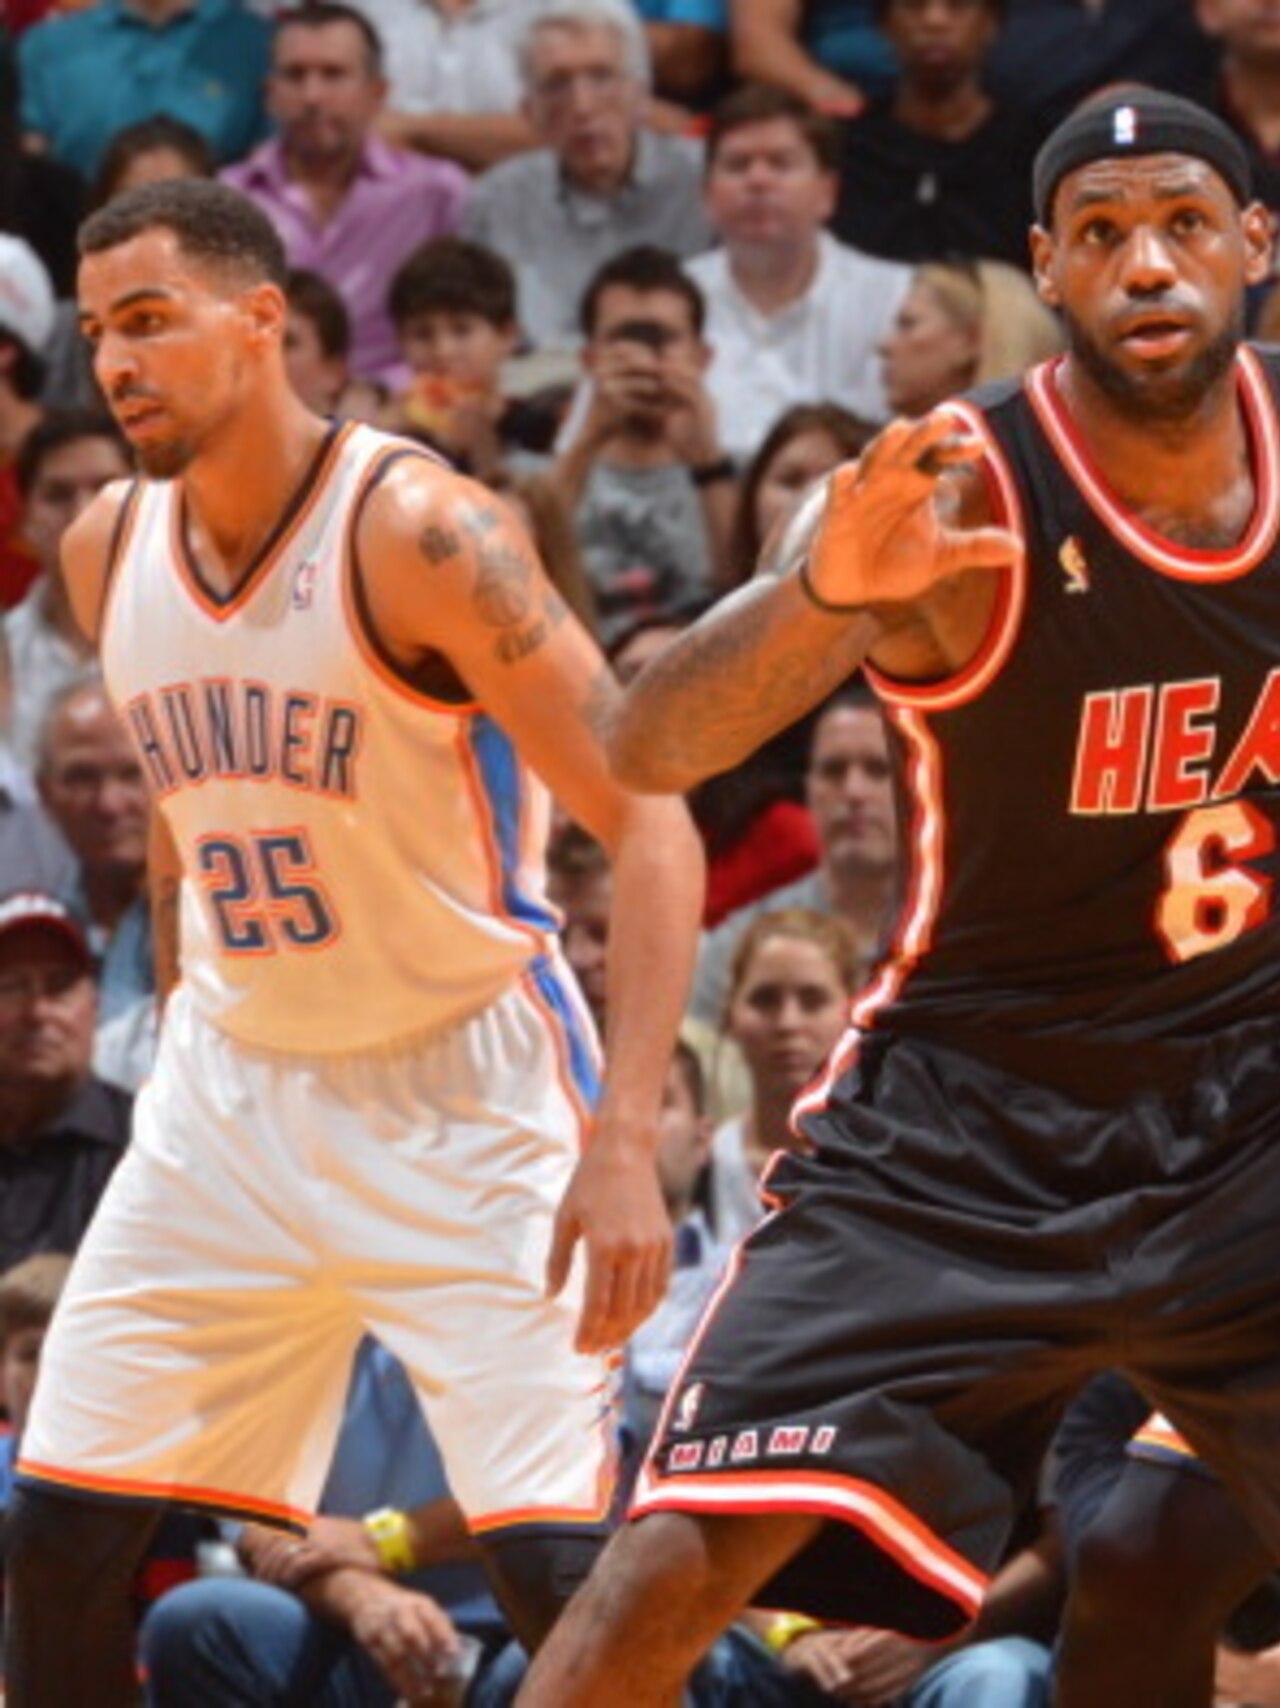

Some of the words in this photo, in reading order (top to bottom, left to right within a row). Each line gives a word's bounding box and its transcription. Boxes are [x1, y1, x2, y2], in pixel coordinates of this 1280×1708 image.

[122, 677, 363, 801] HUNDER
[195, 826, 341, 956] 25
[1154, 799, 1277, 965] 6
[667, 1425, 837, 1470] MIAMI
